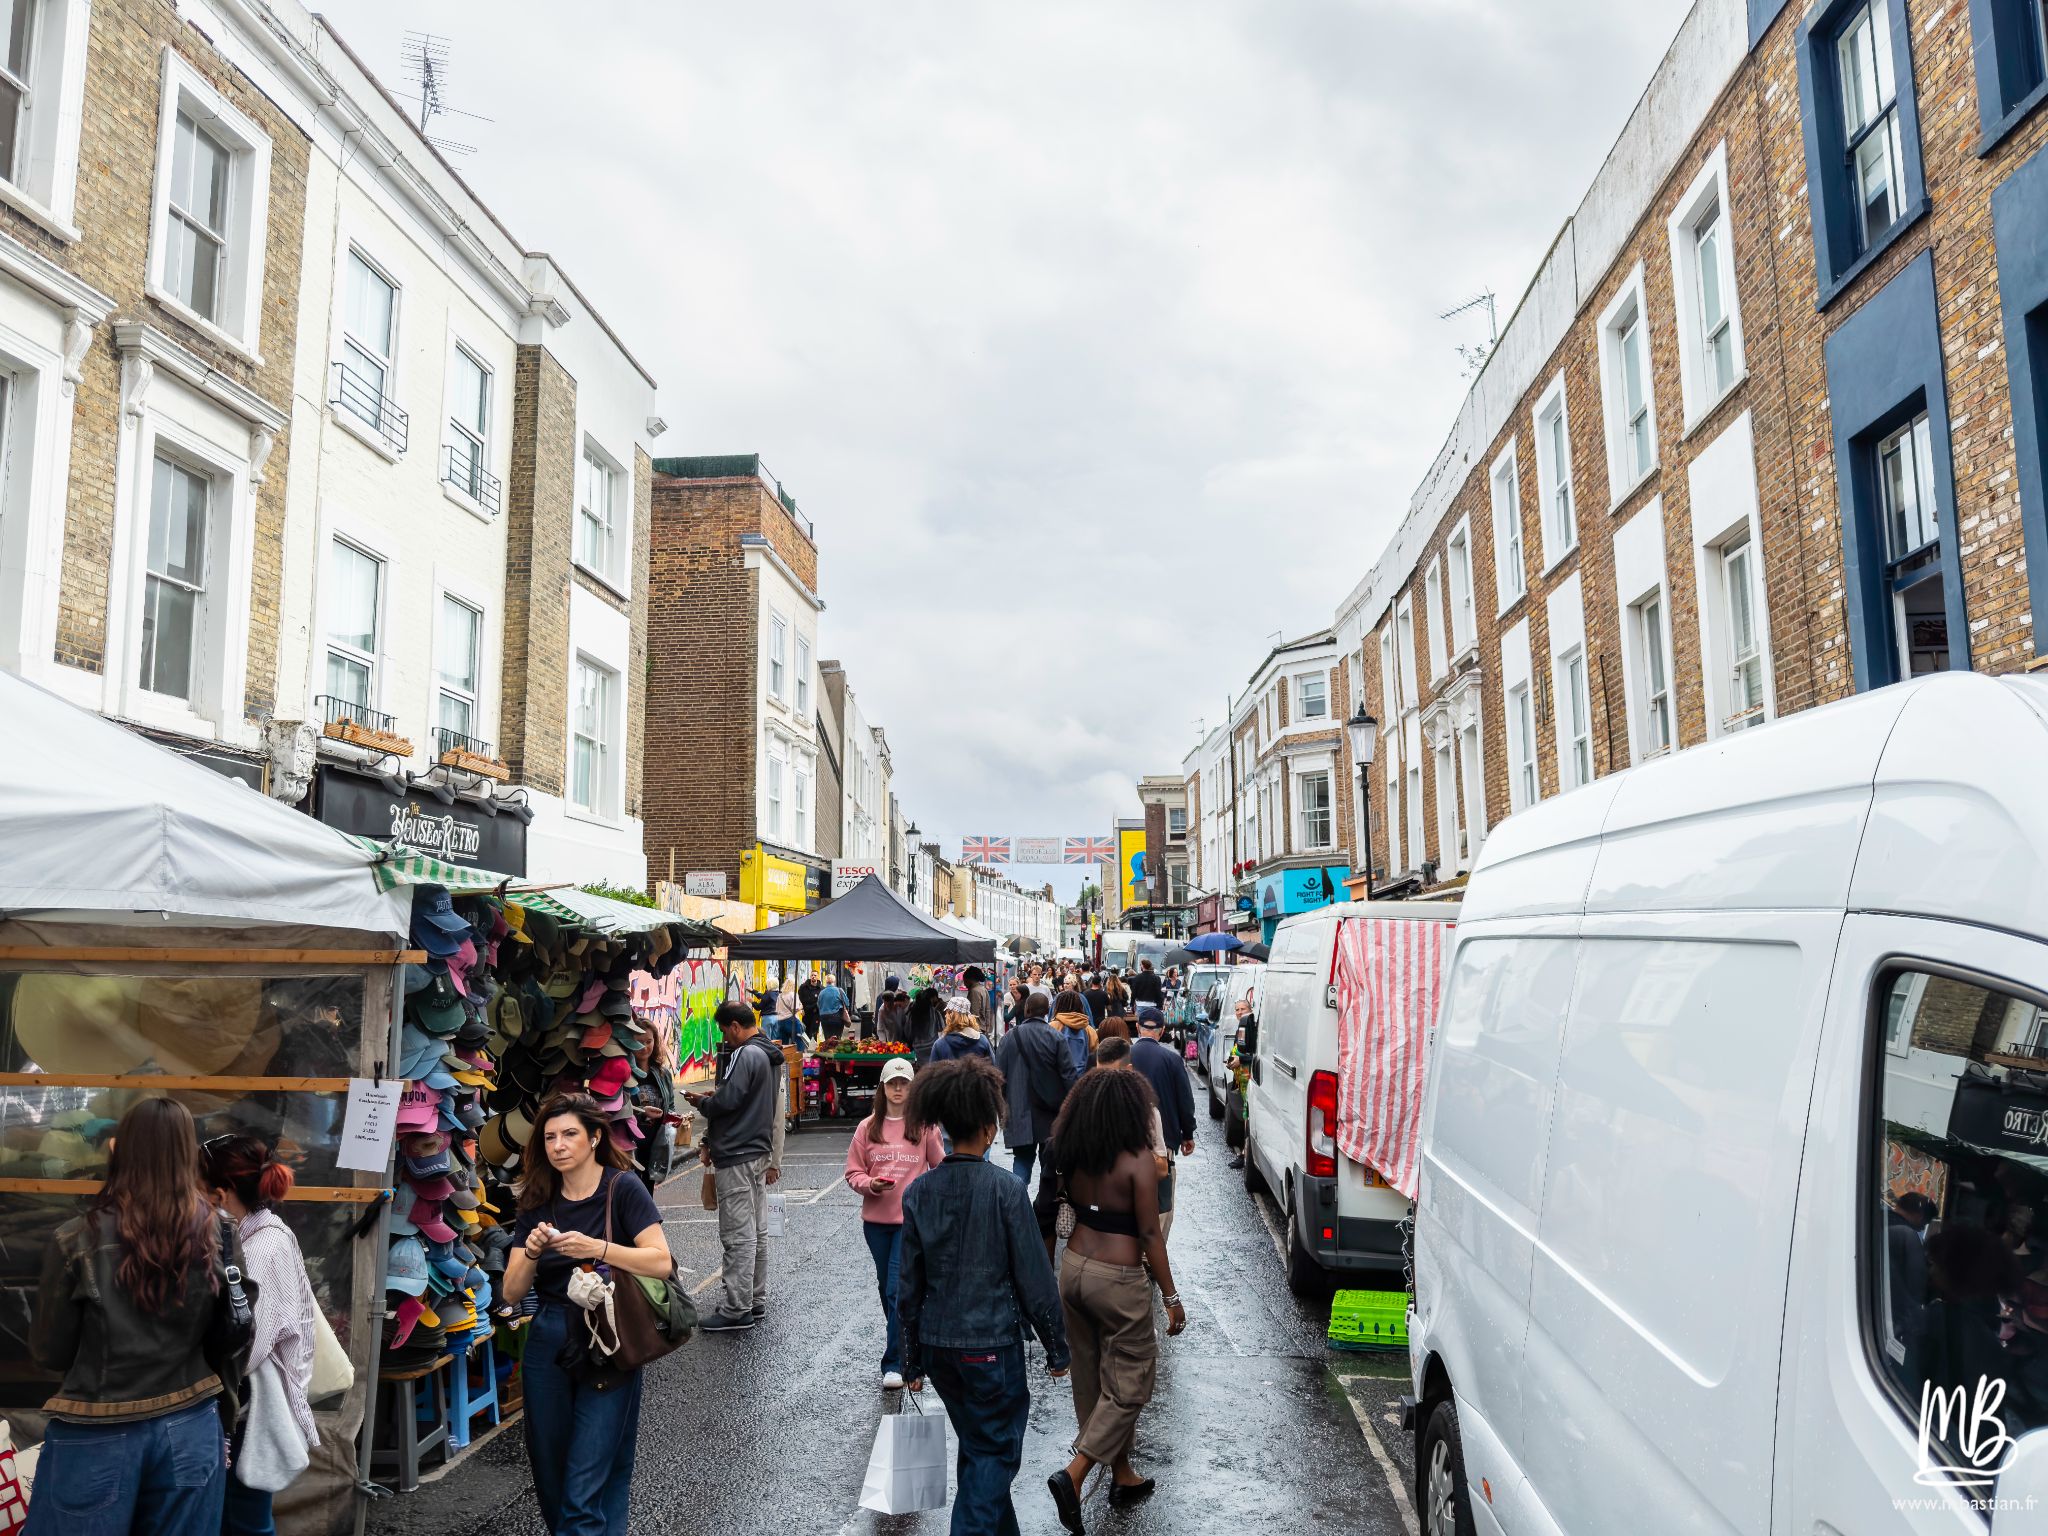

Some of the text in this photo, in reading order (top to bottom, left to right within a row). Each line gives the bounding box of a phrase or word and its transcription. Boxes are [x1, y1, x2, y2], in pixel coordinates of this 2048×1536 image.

[438, 815, 480, 861] RETRO
[837, 866, 875, 875] TESCO
[401, 1089, 427, 1104] NDON
